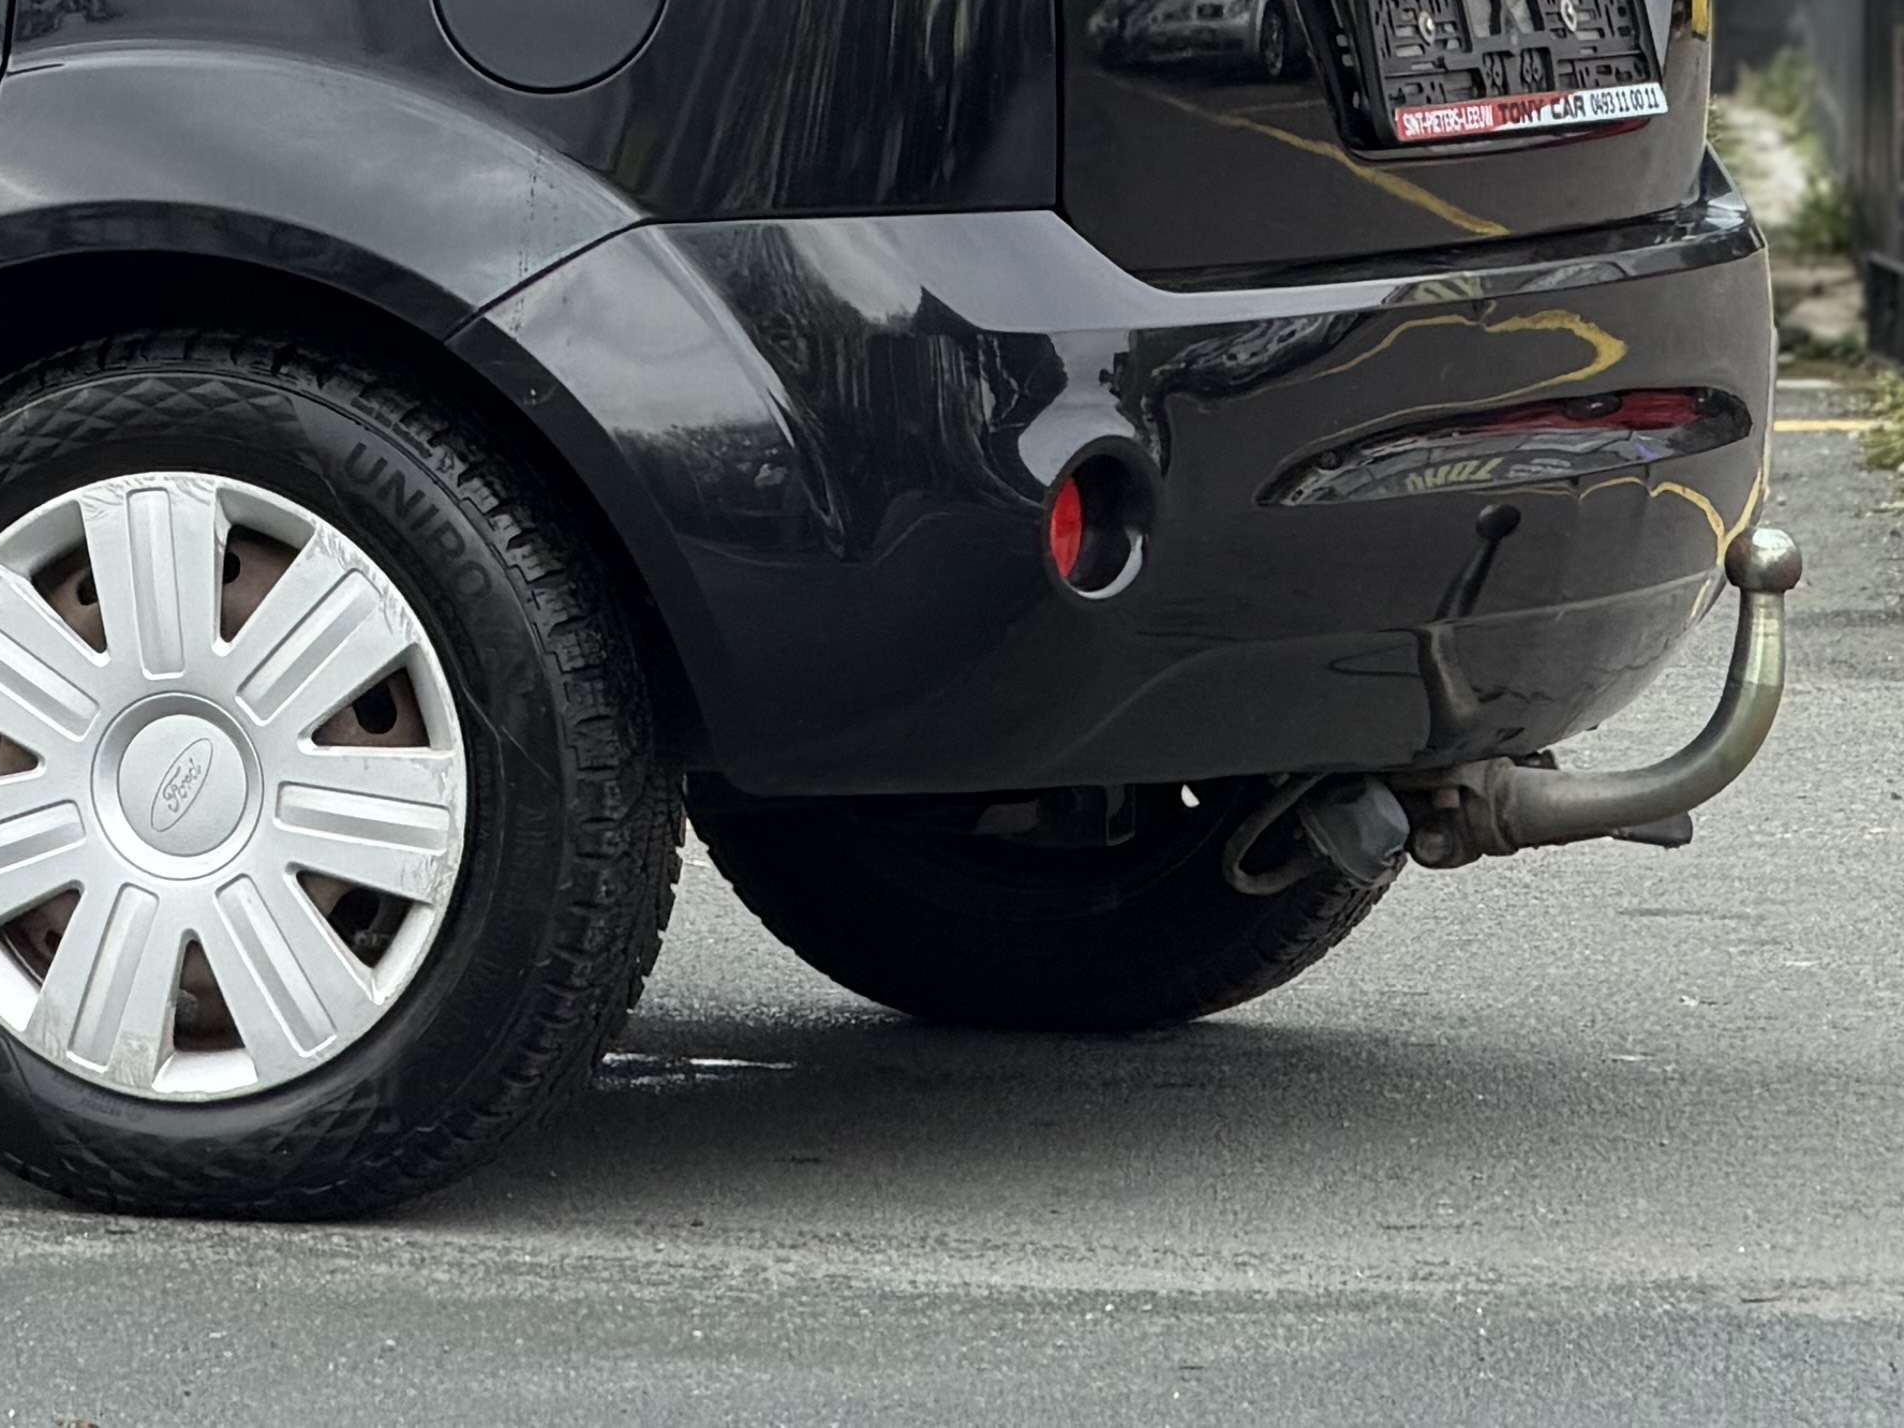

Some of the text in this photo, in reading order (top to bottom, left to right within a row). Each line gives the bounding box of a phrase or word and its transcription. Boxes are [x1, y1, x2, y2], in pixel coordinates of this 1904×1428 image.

[1498, 98, 1547, 125] TONY
[1550, 94, 1586, 120] CAR
[1591, 93, 1616, 116] 0493
[1617, 91, 1631, 112] 11
[1646, 87, 1661, 109] 11
[162, 756, 202, 814] Ford
